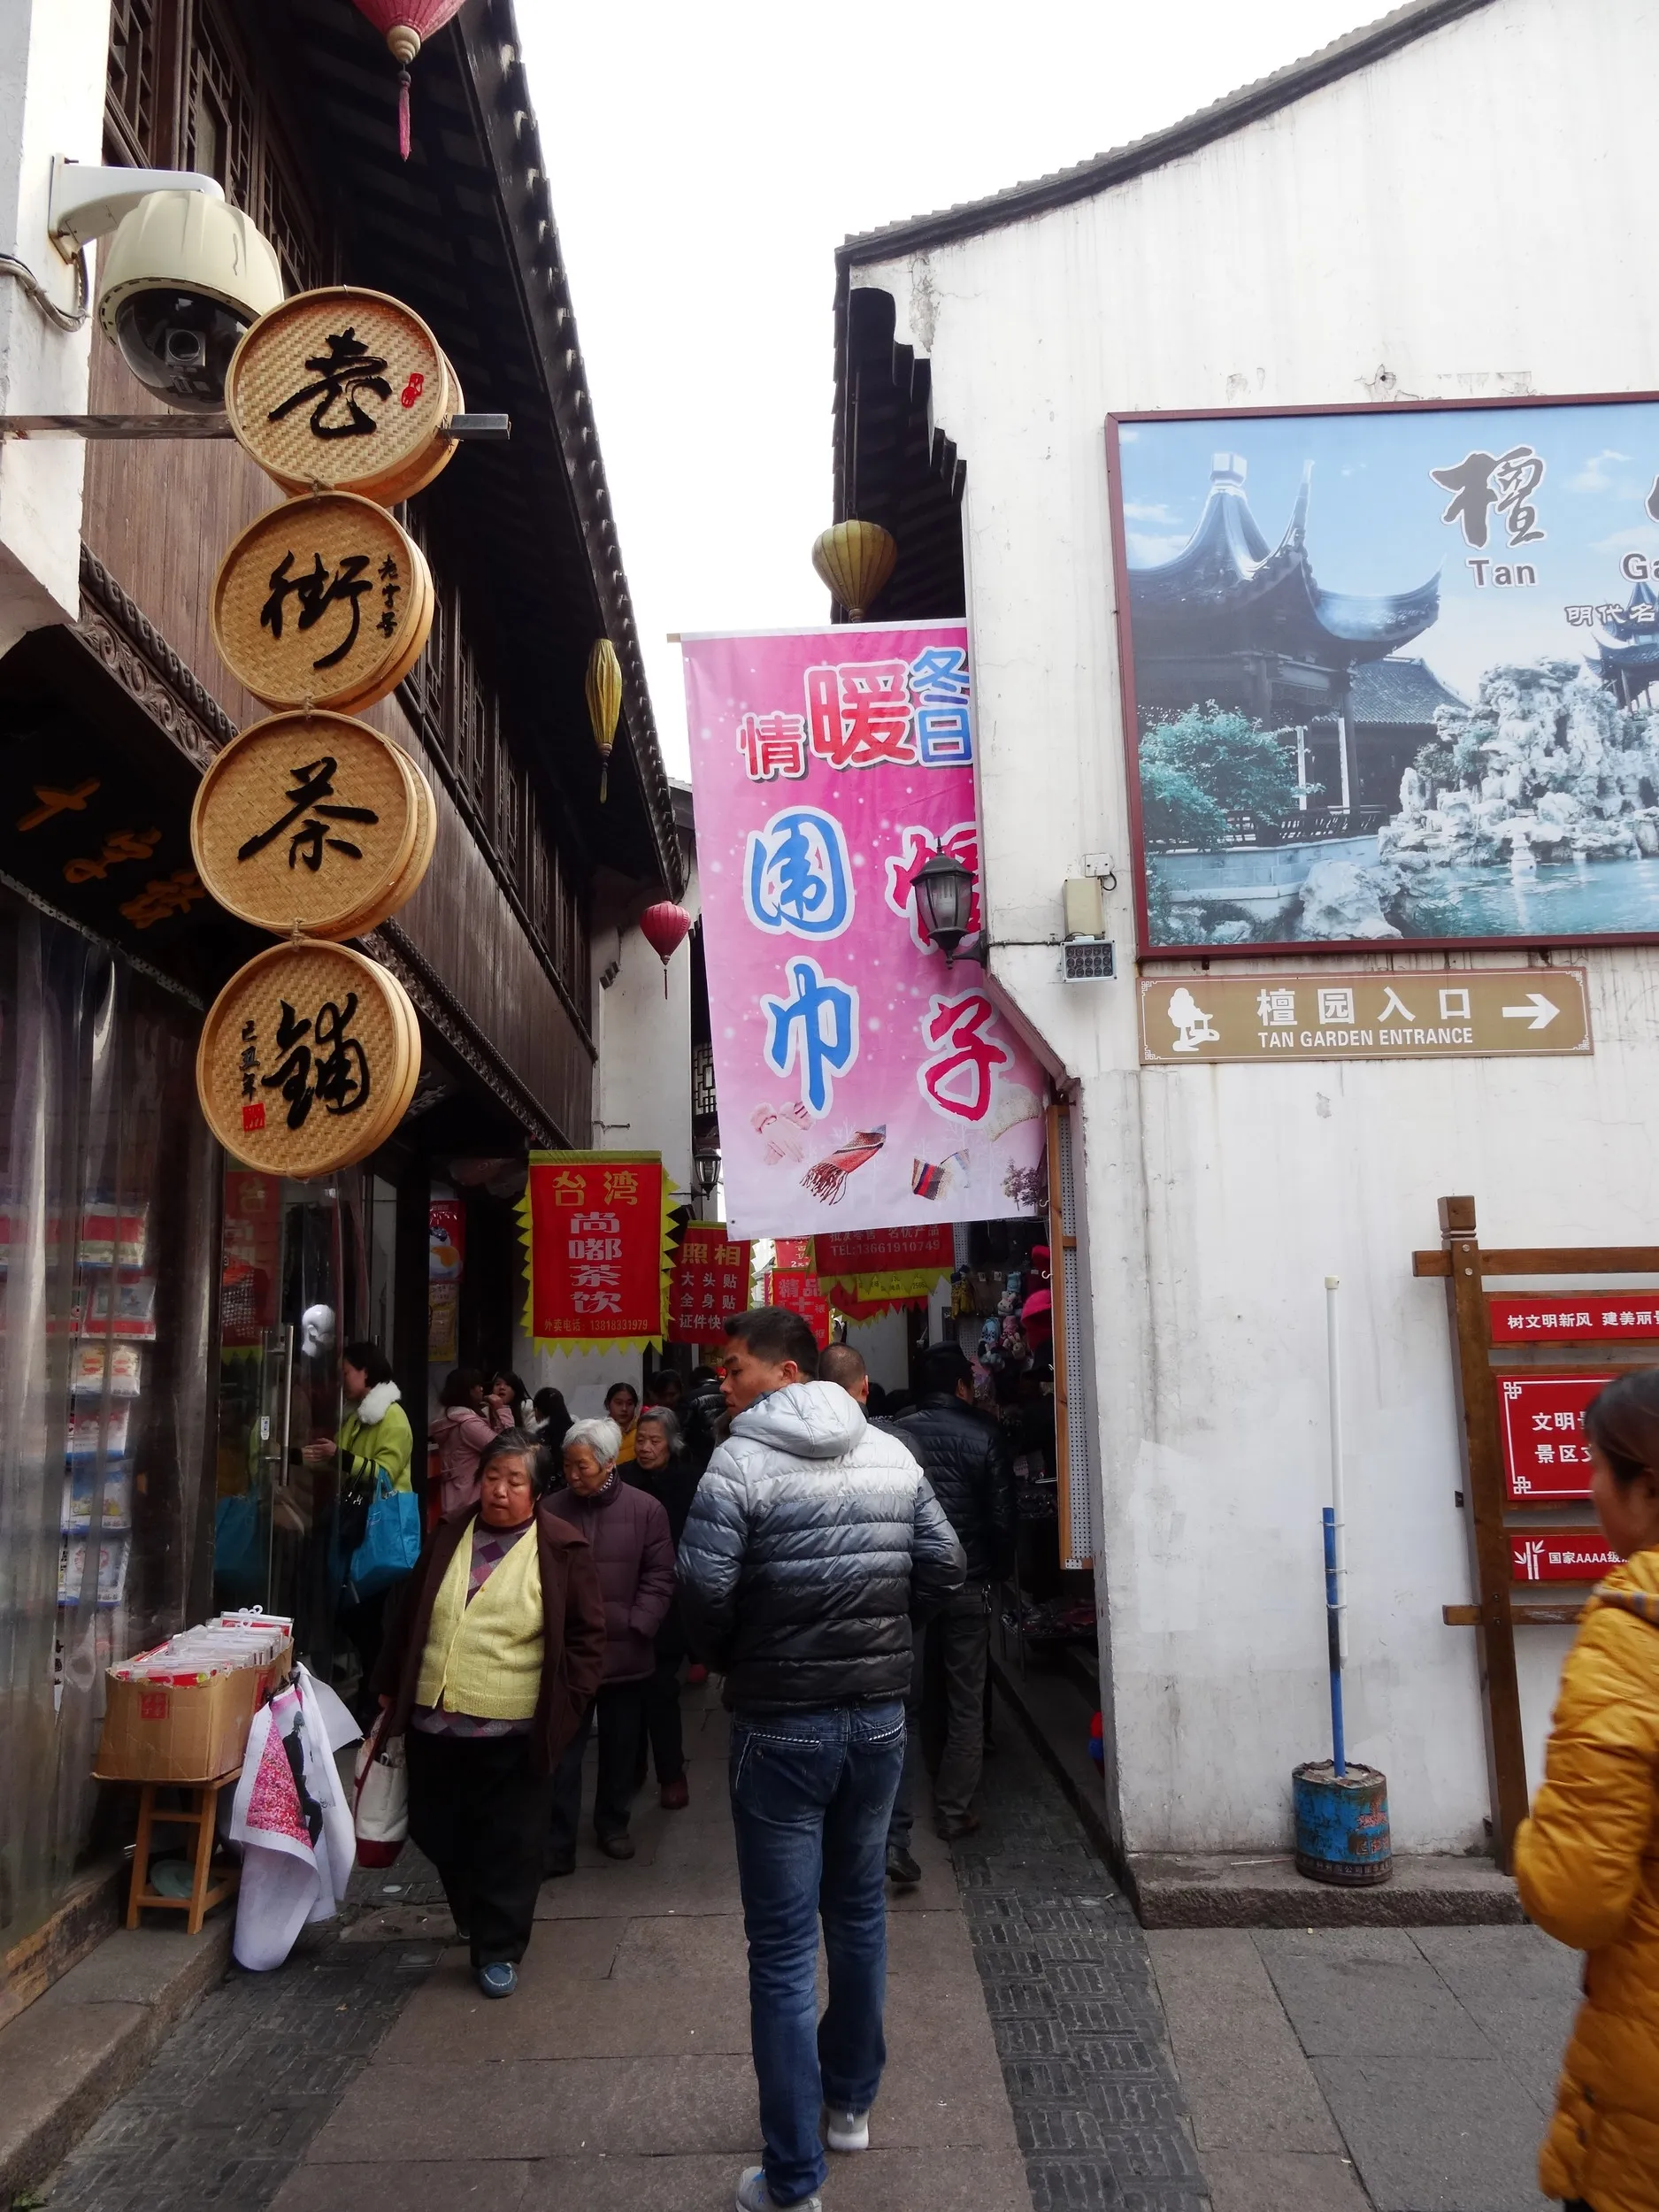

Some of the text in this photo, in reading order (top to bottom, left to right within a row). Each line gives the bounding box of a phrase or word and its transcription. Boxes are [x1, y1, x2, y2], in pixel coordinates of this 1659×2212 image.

[1431, 446, 1546, 549] 檀
[1468, 558, 1536, 586] Tan
[377, 555, 401, 639] 老字号
[749, 809, 856, 1117] 围巾
[1256, 987, 1471, 1026] 檀园入口
[1258, 1028, 1473, 1048] TAN GARDEN ENTRANCE
[552, 1170, 639, 1207] 台湾
[569, 1211, 624, 1315] 尚嘟茶饮
[681, 1242, 741, 1266] 照相
[681, 1271, 738, 1289] 大头贴
[680, 1294, 736, 1310] 全身贴
[680, 1314, 726, 1331] 证件快
[1508, 1312, 1593, 1330] 树文明新风
[1548, 1550, 1630, 1564] 国家AAAA级
